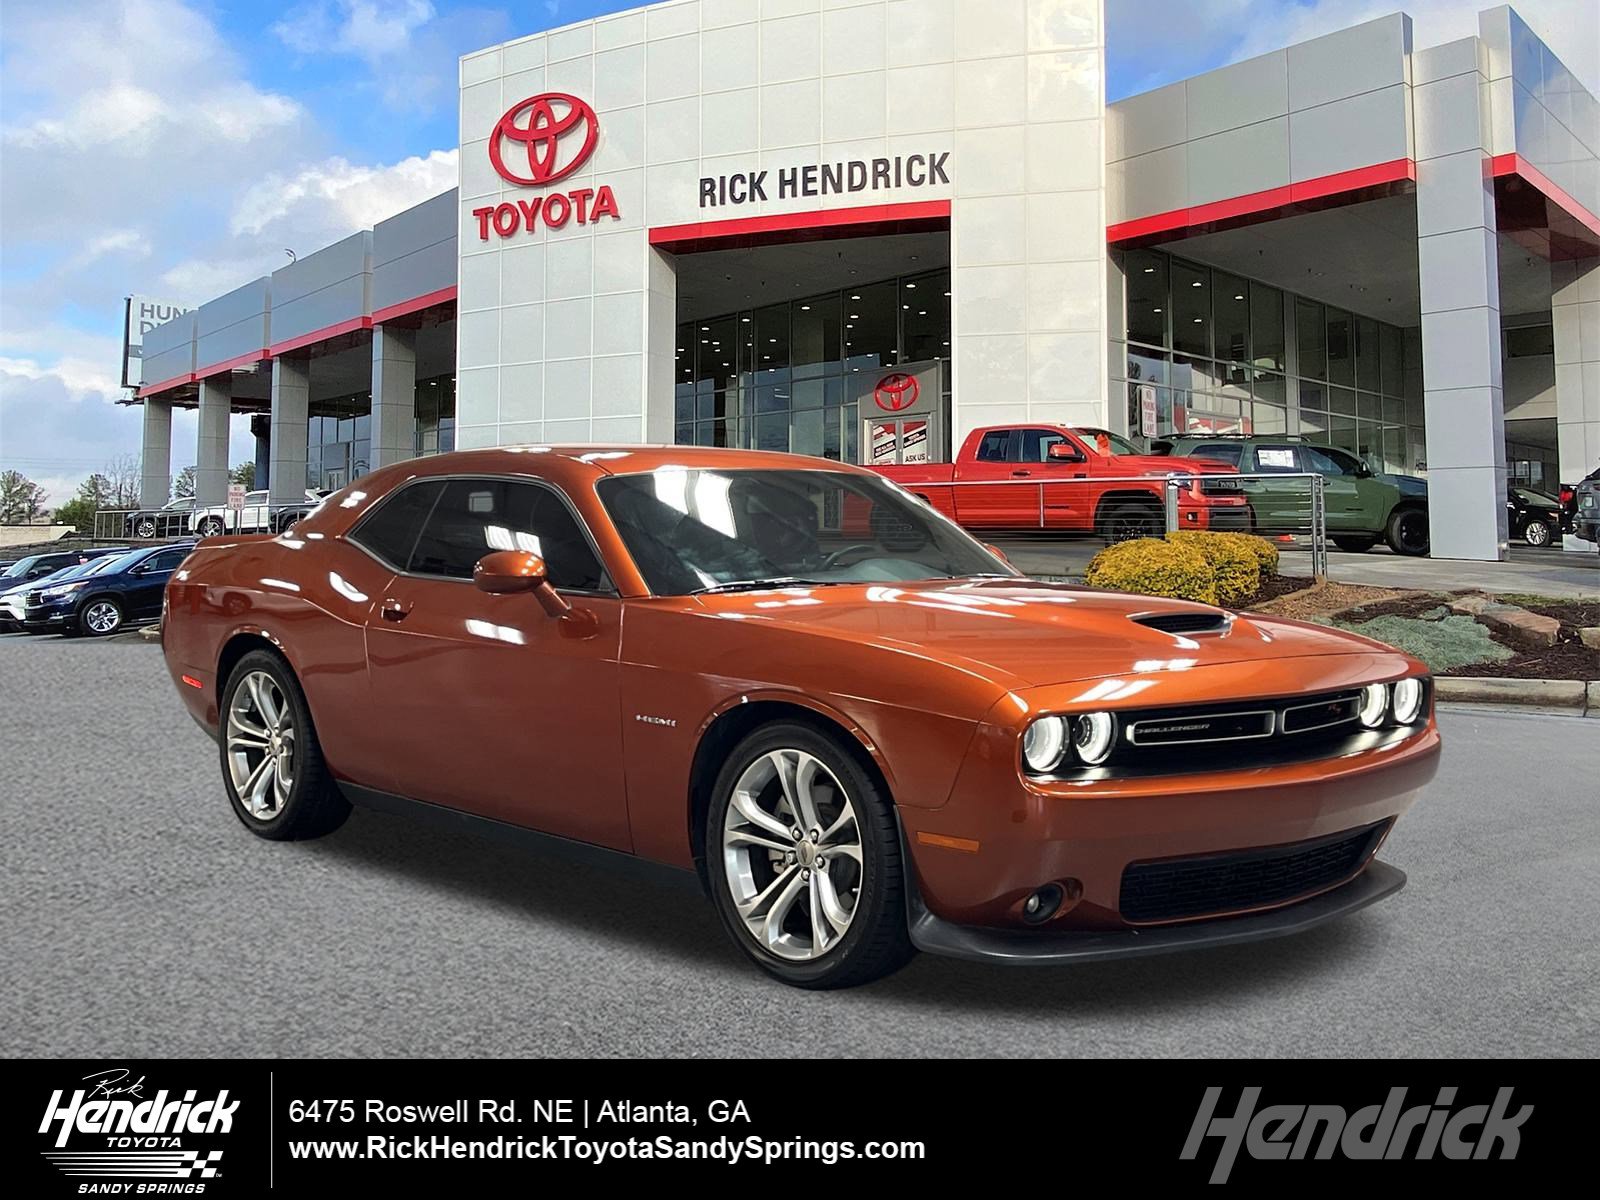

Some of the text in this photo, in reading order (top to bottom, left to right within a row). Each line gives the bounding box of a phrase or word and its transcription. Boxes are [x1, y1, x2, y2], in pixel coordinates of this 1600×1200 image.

[699, 152, 950, 208] RICK HENDRICK
[473, 185, 620, 241] TOYOTA
[905, 453, 926, 463] ASK US
